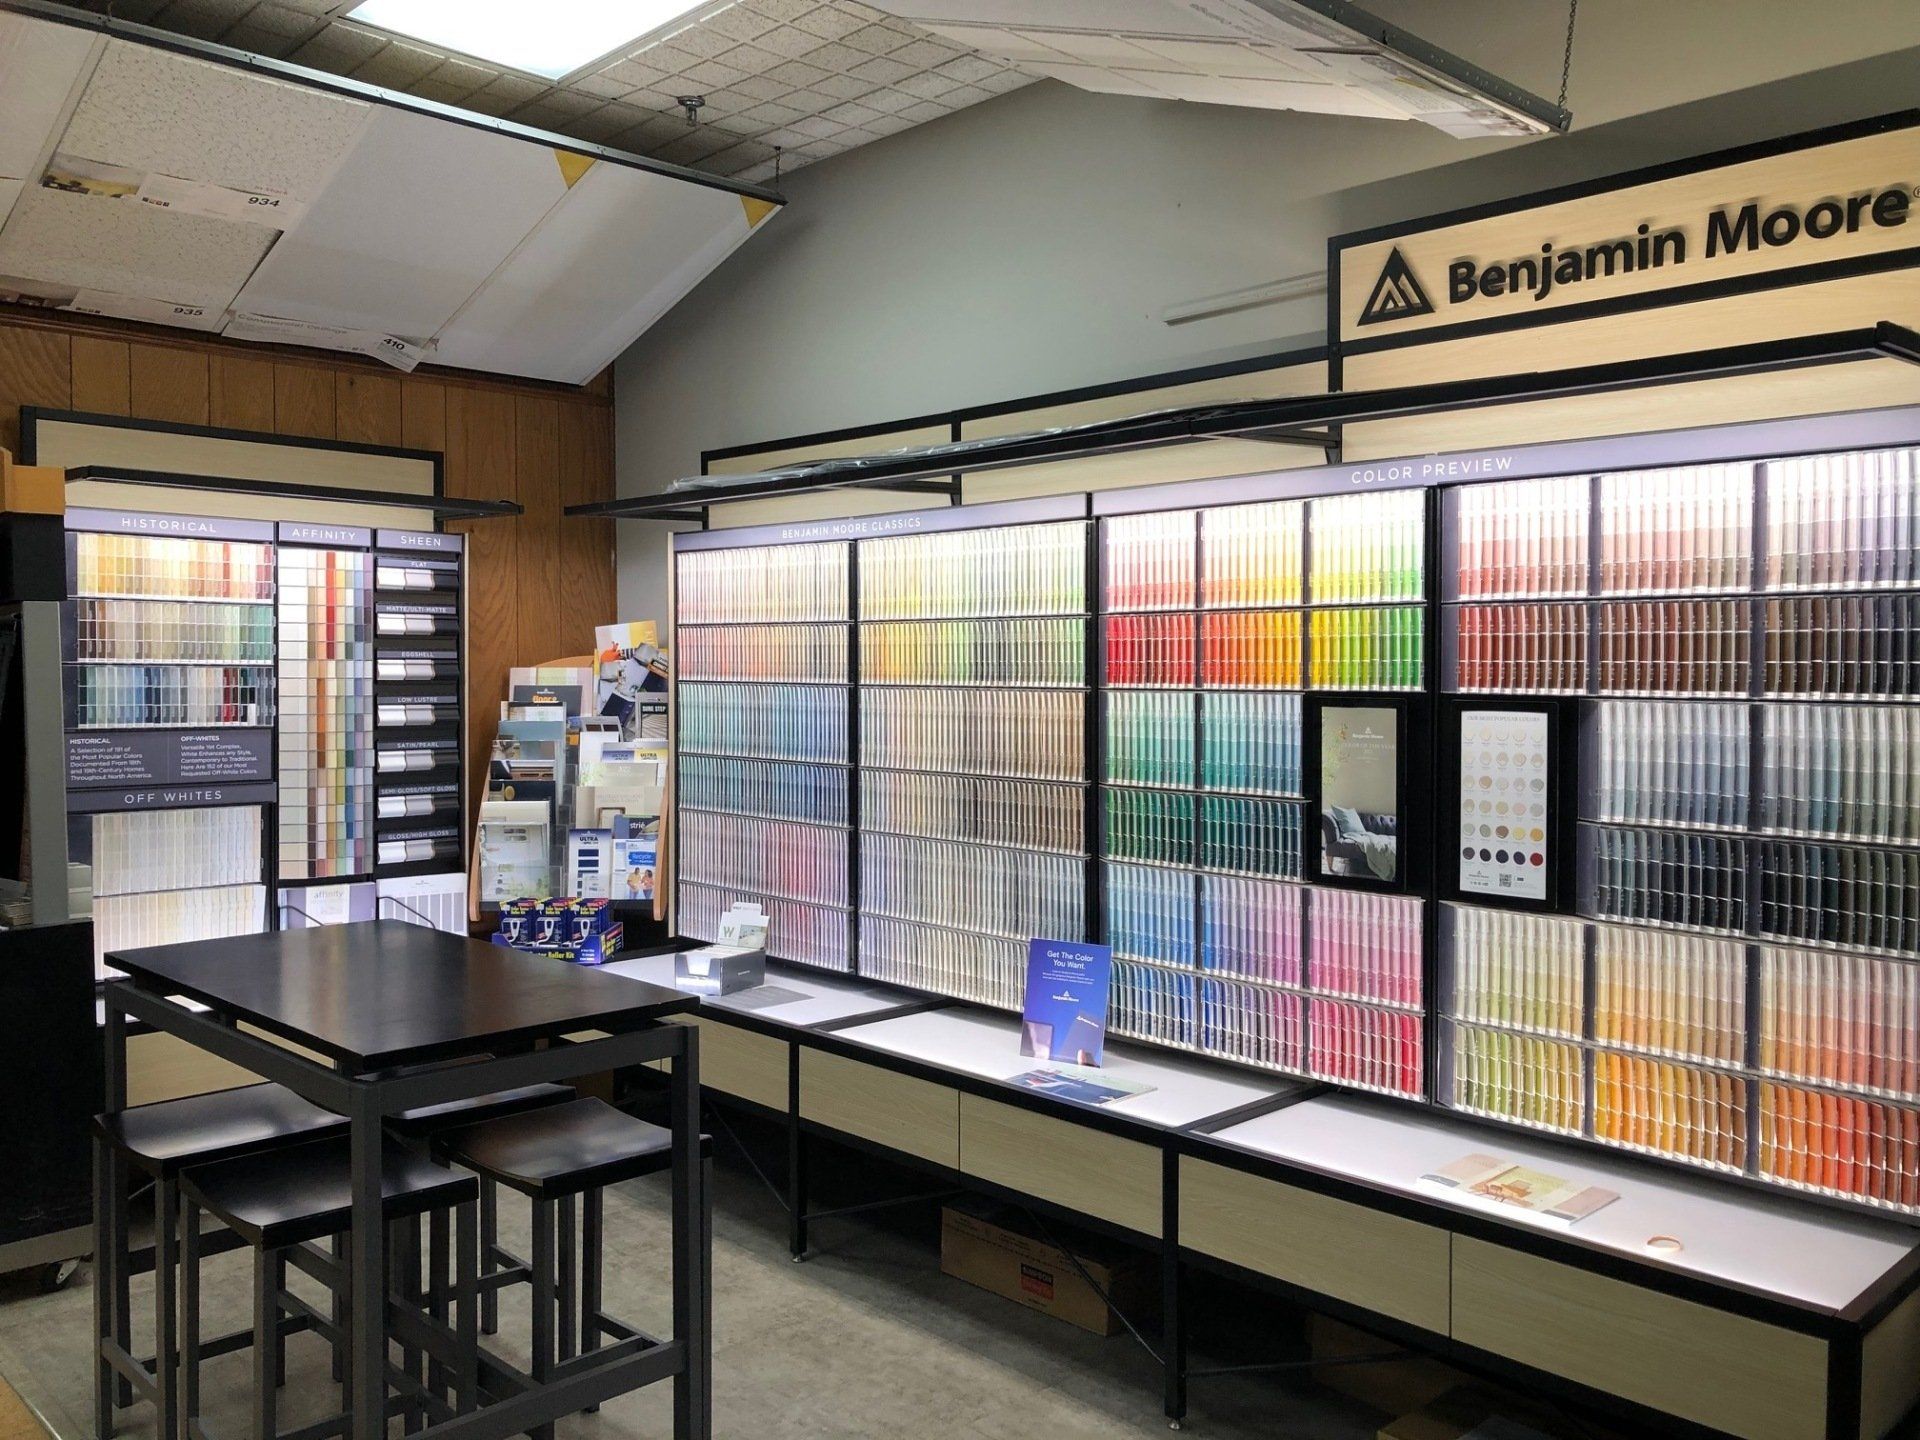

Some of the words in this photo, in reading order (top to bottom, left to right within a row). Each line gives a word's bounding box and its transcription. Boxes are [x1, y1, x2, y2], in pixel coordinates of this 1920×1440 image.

[248, 197, 280, 207] 934
[1449, 224, 1685, 303] Benjamin
[1705, 189, 1909, 258] Moore
[173, 307, 204, 316] 935
[383, 338, 405, 351] 410
[1352, 467, 1413, 484] COLOR
[1423, 457, 1513, 477] PREVIEW
[122, 517, 216, 533] HISTORICAL
[782, 526, 829, 539] BENJAMIN
[832, 522, 867, 534] MOORE
[871, 517, 921, 531] CLASSICS
[292, 528, 356, 541] AFFINITY
[400, 536, 441, 547] SHEEN
[124, 793, 155, 804] OFF
[163, 790, 222, 802] WHITES
[388, 832, 428, 840] GLOSS/HIGH
[1047, 950, 1059, 958] Get
[1061, 951, 1073, 960] The
[1074, 953, 1094, 962] Color
[1053, 959, 1066, 967] You
[1067, 961, 1086, 969] Want.
